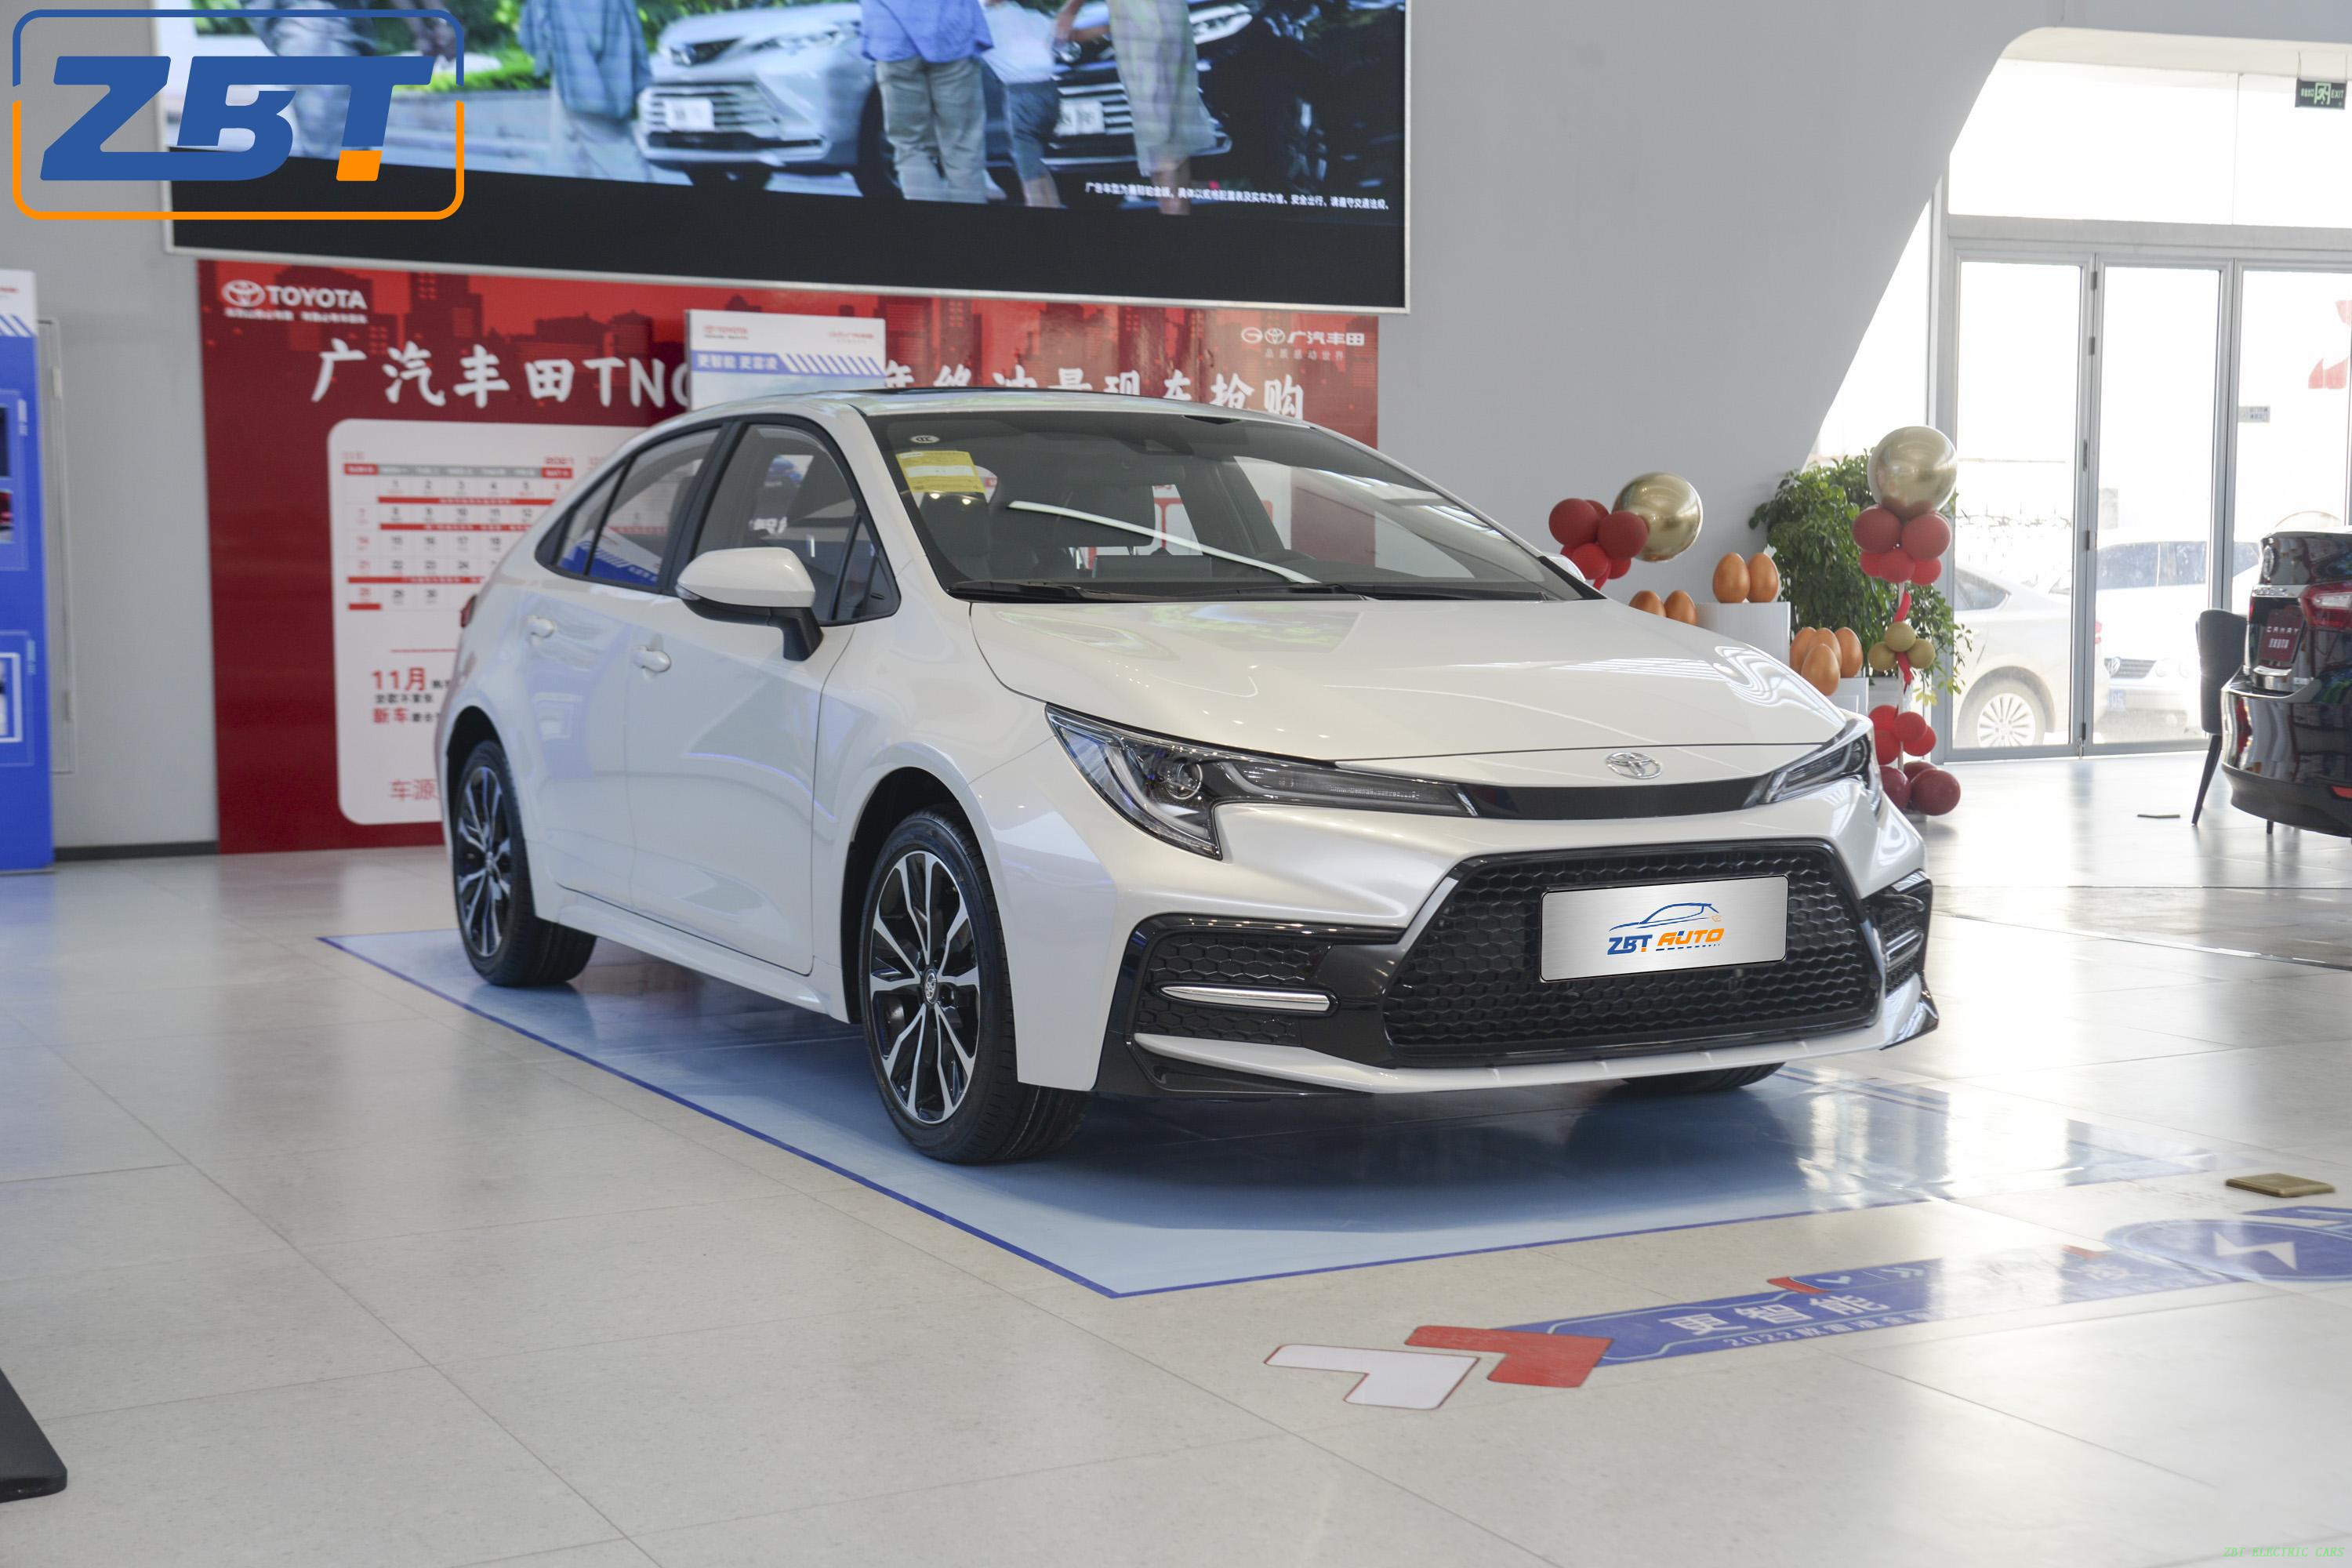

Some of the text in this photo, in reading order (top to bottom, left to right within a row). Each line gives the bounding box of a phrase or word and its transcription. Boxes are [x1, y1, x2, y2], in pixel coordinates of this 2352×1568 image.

[2331, 89, 2344, 100] EXIT
[265, 285, 368, 310] TOYOTA
[1287, 331, 1365, 347] 广汽丰田
[372, 667, 426, 691] 11月
[1607, 927, 1724, 955] ZBT AUTO
[1658, 1294, 1892, 1335] 更智能
